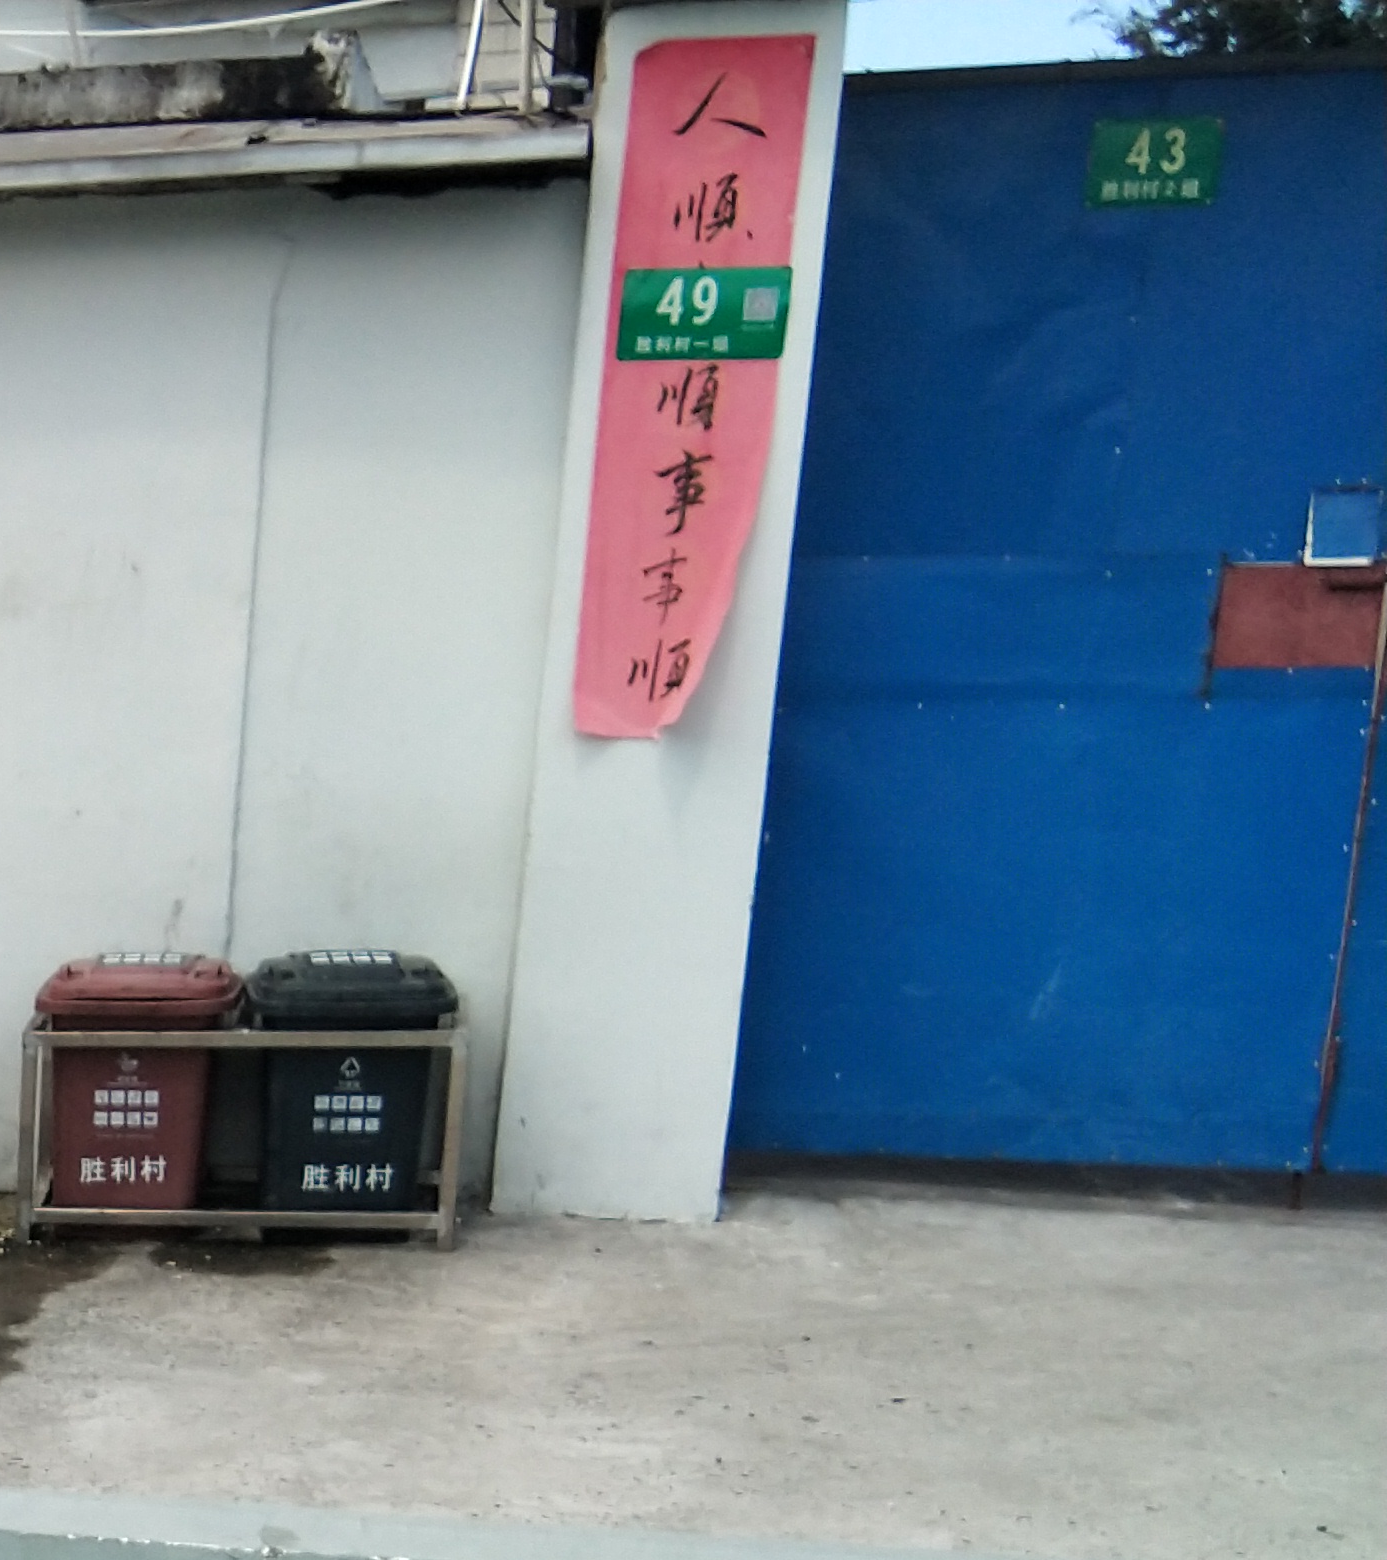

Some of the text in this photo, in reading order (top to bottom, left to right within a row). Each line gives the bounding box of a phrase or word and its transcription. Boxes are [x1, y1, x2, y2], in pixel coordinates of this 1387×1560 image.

[1125, 127, 1187, 175] 43
[656, 275, 719, 327] 49
[79, 1154, 167, 1184] 胜利村
[301, 1163, 394, 1192] 胜利村
